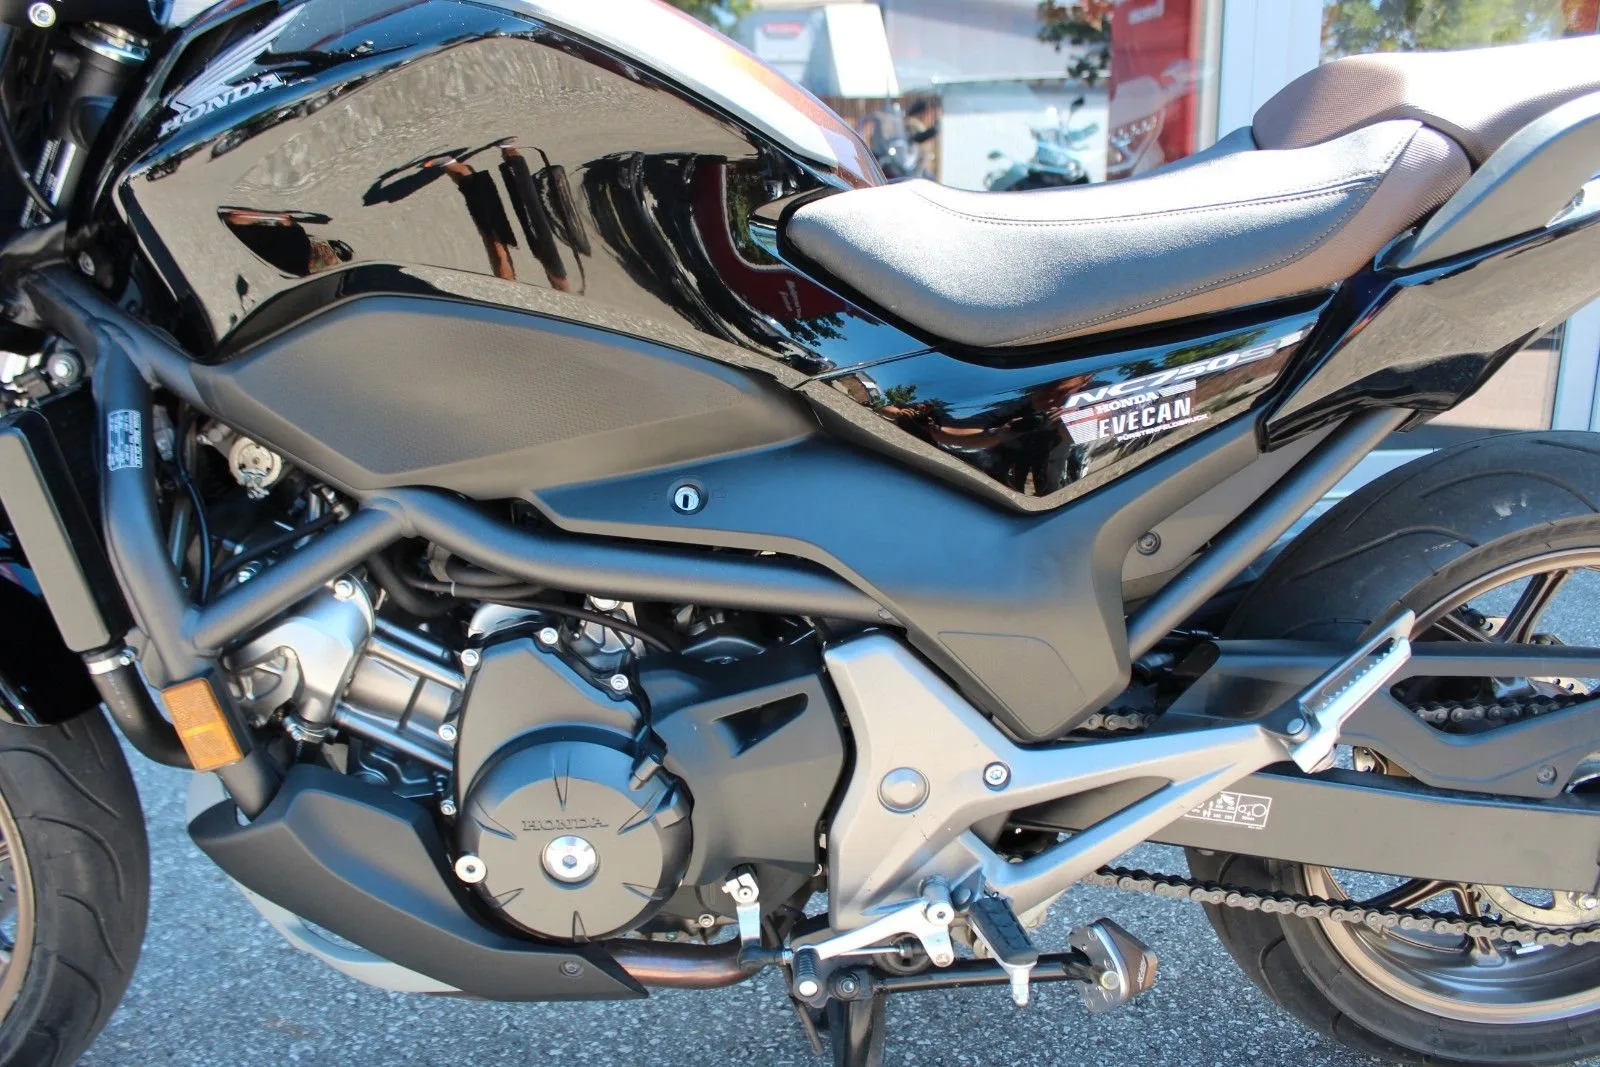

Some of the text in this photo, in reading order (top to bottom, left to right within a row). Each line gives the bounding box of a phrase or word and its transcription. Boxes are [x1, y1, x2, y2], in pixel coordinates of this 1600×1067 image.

[158, 72, 284, 138] HONDA
[1062, 342, 1280, 408] NC750S
[1095, 391, 1160, 415] HONDA
[1098, 397, 1192, 440] EVECAN
[521, 817, 609, 831] HONDA
